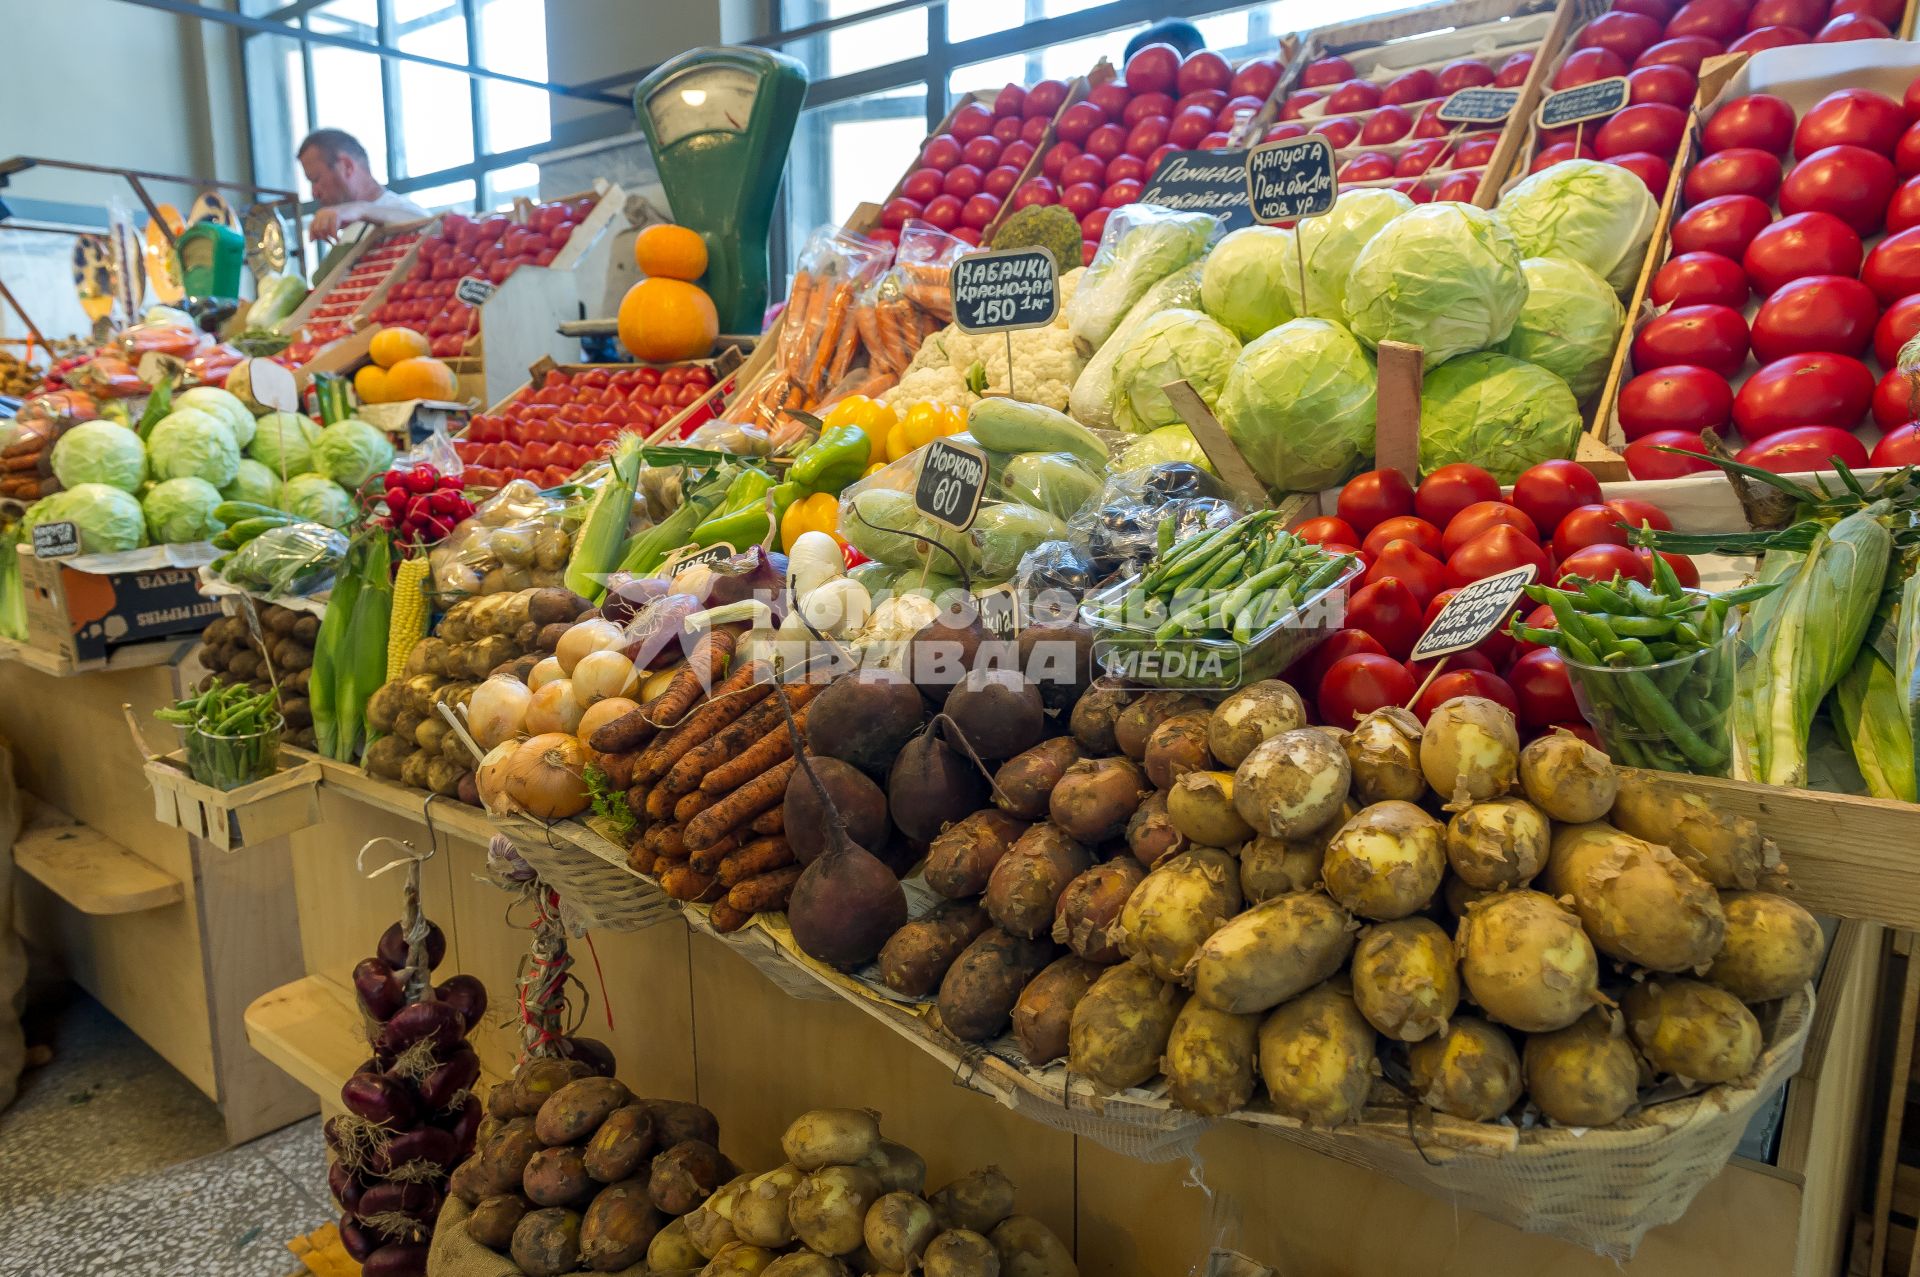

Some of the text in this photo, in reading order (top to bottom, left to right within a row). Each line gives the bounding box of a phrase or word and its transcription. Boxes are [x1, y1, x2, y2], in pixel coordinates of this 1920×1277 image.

[1253, 143, 1323, 172] КАПУСТА
[1296, 196, 1314, 215] УР
[957, 258, 1052, 286] КАБАЧКИ
[956, 279, 1053, 304] КРАСНОДАР
[971, 295, 1050, 325] 150 1кг
[932, 477, 962, 516] 60
[136, 606, 191, 627] PEPPERS
[1471, 606, 1495, 625] УР
